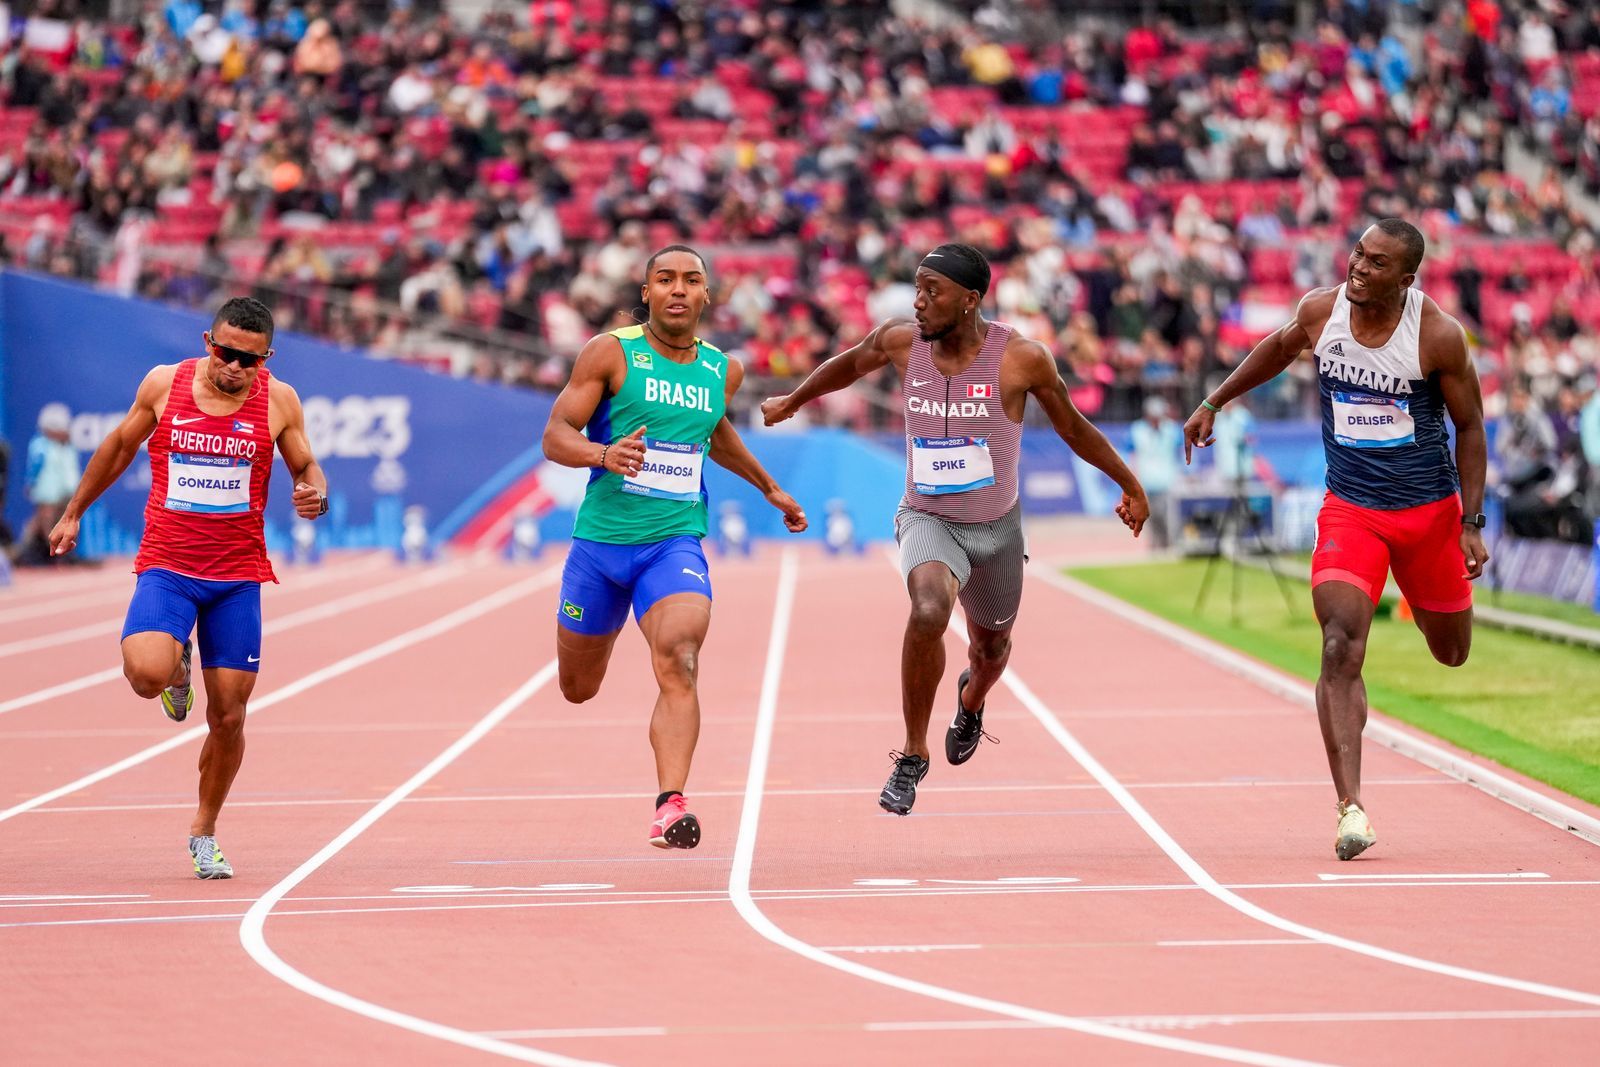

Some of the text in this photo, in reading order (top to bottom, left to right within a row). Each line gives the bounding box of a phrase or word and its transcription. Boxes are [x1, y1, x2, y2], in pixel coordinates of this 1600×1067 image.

[1319, 360, 1413, 395] PANAMA
[645, 377, 713, 413] BRASIL
[908, 396, 990, 417] CANADA
[1347, 415, 1394, 426] DELISER
[170, 429, 222, 453] PUERTO
[225, 437, 256, 458] RICO
[642, 461, 693, 477] BARBOSA
[932, 459, 966, 471] SPIKE
[178, 477, 241, 489] GONZALEZ
